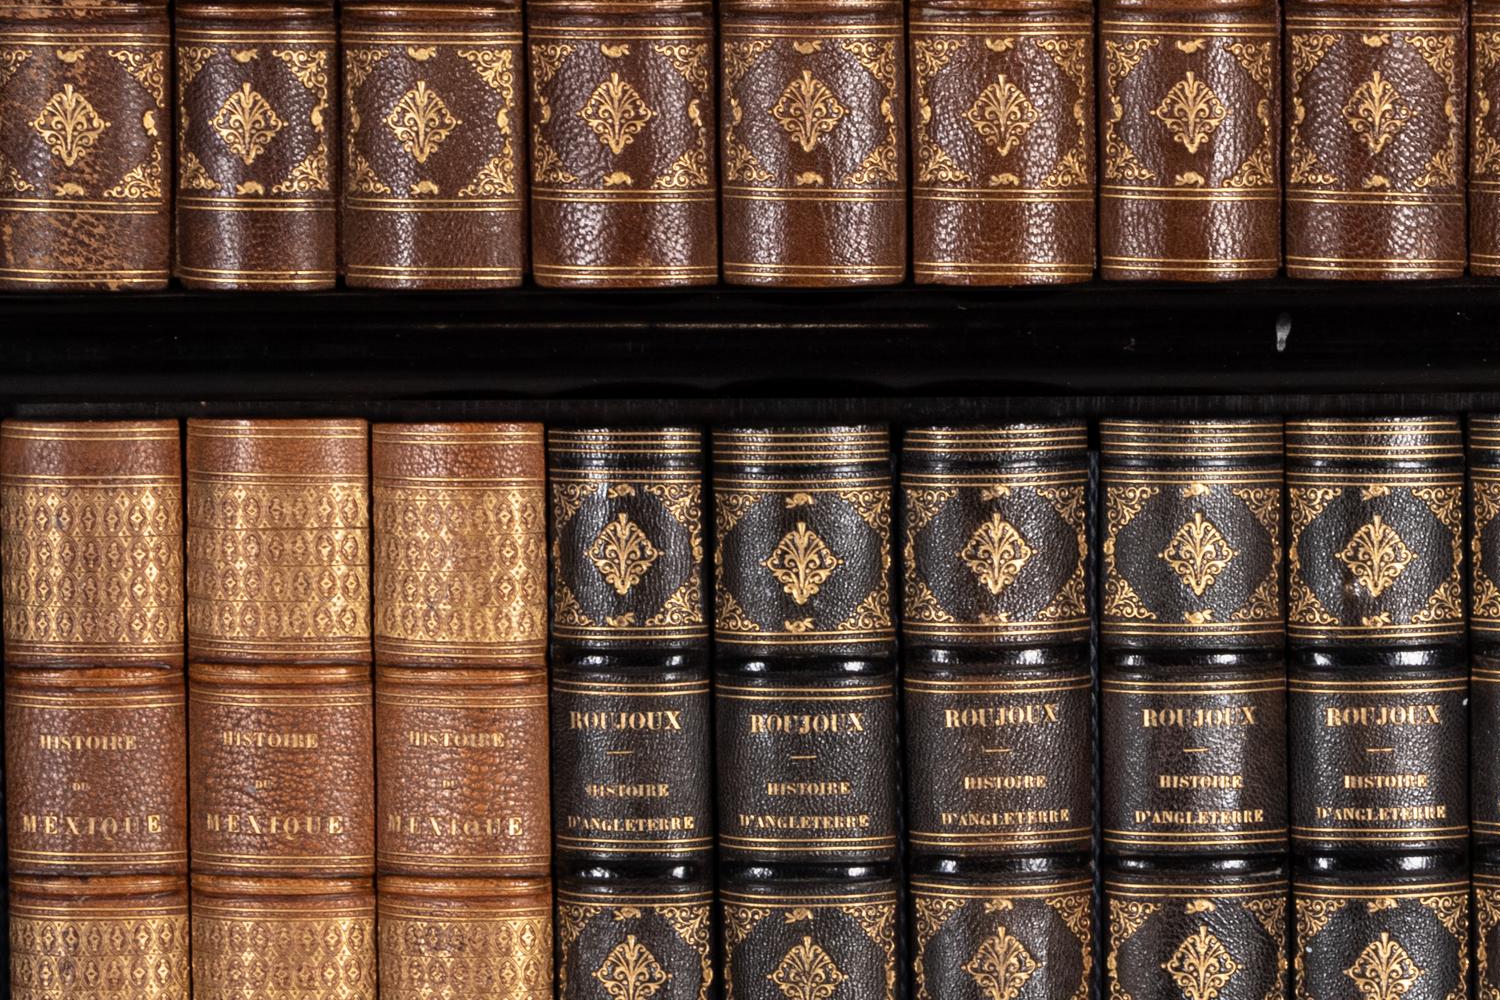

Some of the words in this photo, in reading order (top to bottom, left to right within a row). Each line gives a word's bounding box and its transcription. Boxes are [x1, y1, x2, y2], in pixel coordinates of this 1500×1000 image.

[569, 710, 681, 734] ROUJOUX
[751, 712, 866, 735] ROUJOUX
[944, 704, 1059, 729] ROUJOUX
[1142, 705, 1256, 728] ROUJOUX
[1327, 704, 1441, 728] ROUJOUX
[40, 734, 136, 751] HISTOIRE
[223, 730, 319, 749] HISTOIRE
[409, 730, 504, 749] HISTOIRE
[72, 781, 90, 792] DU
[255, 779, 271, 790] DU
[443, 778, 459, 789] DU
[586, 782, 669, 799] HISTOIRE
[767, 780, 850, 798] HISTOIRE
[964, 775, 1046, 791] HISTOIRE
[1159, 774, 1242, 791] HISTOIRE
[1344, 774, 1427, 790] HISTOIRE
[568, 814, 694, 833] D'ANGLETERRE
[739, 809, 869, 830] D'ANGLETERRE
[942, 807, 1069, 828] D'ANGLETERRE
[1136, 808, 1263, 828] D'ANGLETERRE
[1317, 805, 1446, 824] D'ANGLETERRE
